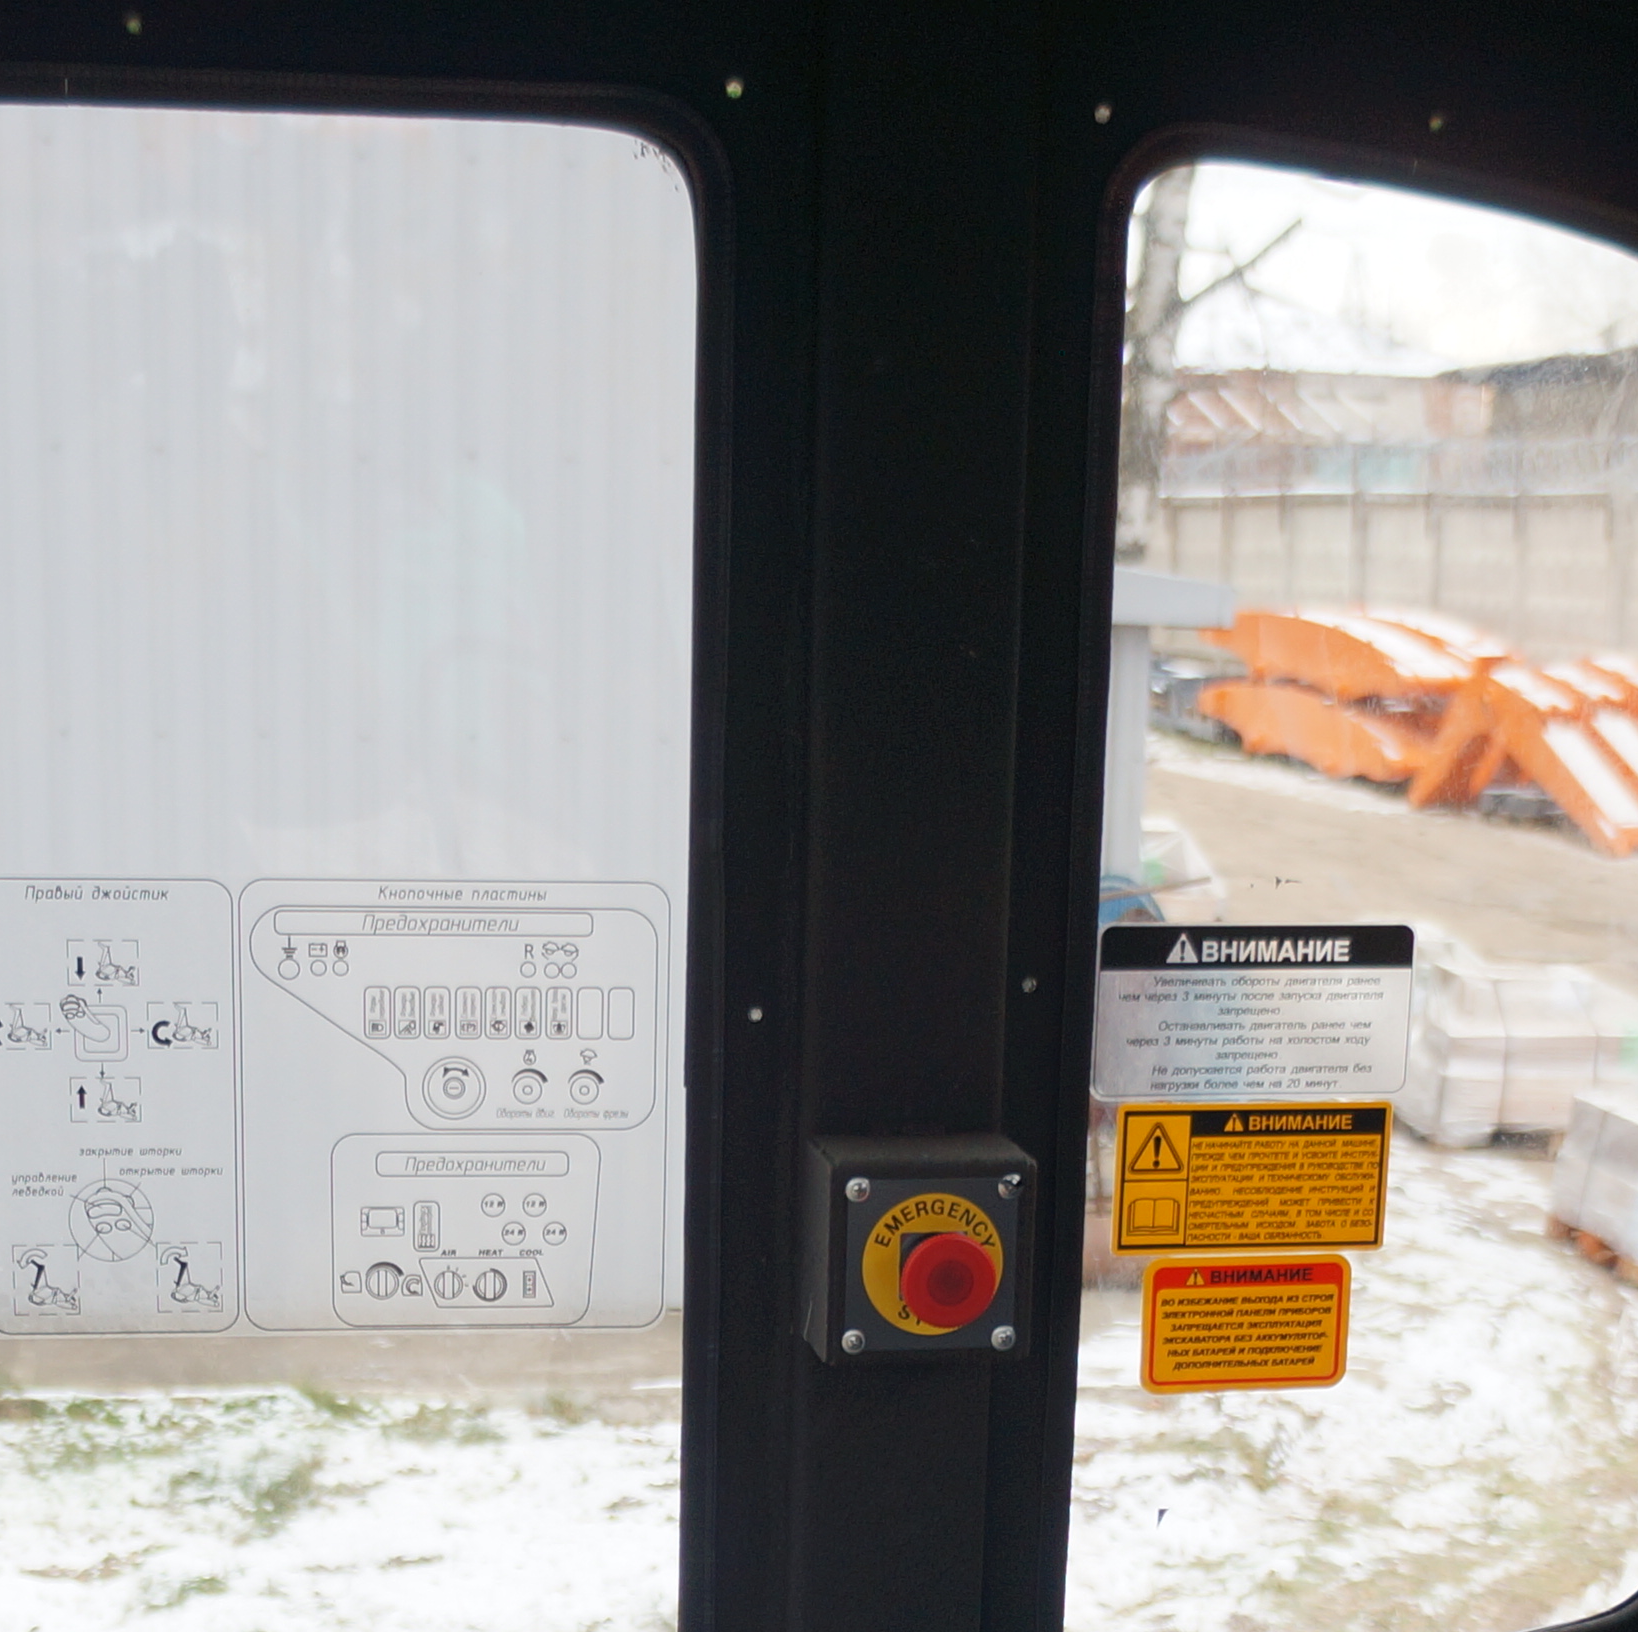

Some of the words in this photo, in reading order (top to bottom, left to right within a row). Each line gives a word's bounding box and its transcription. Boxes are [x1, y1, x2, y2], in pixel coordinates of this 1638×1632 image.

[25, 885, 83, 903] Правый
[92, 886, 168, 900] джойстик
[378, 886, 462, 901] Кнопочные
[472, 889, 547, 901] пластины
[362, 914, 520, 935] Предохранители
[525, 944, 534, 958] R
[1202, 939, 1351, 963] ВНИМАНИЕ
[1154, 976, 1226, 987] Увеличивать
[1232, 977, 1279, 987] обороты
[1284, 977, 1342, 987] двигателя
[1347, 977, 1380, 987] ранее
[1118, 992, 1140, 1002] чем
[1145, 992, 1178, 1004] через
[1182, 991, 1189, 1002] 3
[1194, 993, 1235, 1003] минуты
[1240, 992, 1273, 1002] после
[1279, 992, 1322, 1003] запуска
[1326, 991, 1384, 1002] двигателя
[1158, 1020, 1245, 1032] Останавливать
[1249, 1021, 1306, 1032] двигатель
[1312, 1021, 1345, 1032] ранее
[1351, 1020, 1372, 1030] чем
[1127, 1037, 1159, 1048] через
[1164, 1036, 1171, 1046] 3
[1175, 1036, 1217, 1047] минуты
[1222, 1036, 1264, 1047] работы
[1269, 1036, 1282, 1045] на
[1287, 1035, 1340, 1046] холостом
[1345, 1035, 1371, 1046] ходу
[1152, 1066, 1167, 1076] Не
[1172, 1065, 1242, 1077] допускается
[1247, 1065, 1286, 1076] работа
[1291, 1064, 1348, 1075] двигателя
[1353, 1063, 1372, 1074] без
[1150, 1080, 1199, 1091] нагрузки
[1204, 1080, 1238, 1089] более
[1243, 1080, 1264, 1089] чем
[1269, 1079, 1282, 1089] на
[1286, 1078, 1300, 1089] 20
[1249, 1115, 1353, 1131] ВНИМАНИЕ
[1205, 1141, 1252, 1150] НАЧИНАЙТЕ
[1254, 1141, 1285, 1149] РАБОТУ
[1303, 1139, 1336, 1149] ДАННОЙ
[79, 1148, 133, 1158] закрытие
[139, 1148, 182, 1157] шторки
[1191, 1153, 1224, 1161] ПРЕЖДЕ
[1248, 1152, 1290, 1160] ПРОЧТЕТЕ
[1302, 1151, 1337, 1159] УСВОИТЕ
[119, 1167, 175, 1176] открытие
[181, 1167, 223, 1176] шторки
[405, 1157, 546, 1175] Предохранители
[1220, 1163, 1296, 1172] ПРЕДУПРЕЖДЕНИЯ
[1307, 1162, 1363, 1171] РУКОВОДСТВЕ
[12, 1173, 77, 1185] управление
[1190, 1175, 1254, 1183] ЭКСПЛУАТАЦИИ
[1267, 1174, 1330, 1182] ТЕХНИЧЕСКОМУ
[12, 1185, 64, 1197] лебедкой
[1233, 1186, 1303, 1195] НЕСОБЛЮДЕНИЕ
[1309, 1184, 1364, 1194] ИНСТРУКЦИЙ
[1369, 1185, 1376, 1193] И
[1189, 1199, 1269, 1208] ПРЕДУПРЕЖДЕНИЙ
[1317, 1198, 1362, 1206] ПРИВЕСТИ
[1188, 1211, 1244, 1219] НЕСЧАСТНЫМ
[1296, 1210, 1301, 1218] В
[1324, 1209, 1350, 1217] ЧИСЛЕ
[874, 1199, 996, 1248] EMERGENCY
[1188, 1222, 1249, 1231] СМЕРТЕЛЬНЫМ
[1187, 1233, 1231, 1241] ПАСНОСТИ
[1238, 1232, 1261, 1240] ВАША
[1210, 1267, 1313, 1283] ВНИМАНИЕ
[1161, 1299, 1175, 1307] ВО
[1177, 1297, 1238, 1306] ИЗБЕЖАНИЕ
[1241, 1296, 1283, 1305] ВЫХОДА
[1287, 1295, 1299, 1303] ИЗ
[1302, 1294, 1334, 1303] СТРОЯ
[1162, 1309, 1234, 1319] ЭЛЕКТРОННОЙ
[1236, 1309, 1276, 1318] ПАНЕЛИ
[1278, 1307, 1332, 1316] ПРИБОРОВ
[1171, 1322, 1244, 1332] ЗАПРЕЩАЕТСЯ
[1247, 1320, 1323, 1331] ЭКСПЛУАТАЦИЯ
[1162, 1335, 1231, 1345] ЭКСКАВАТОРА
[1234, 1335, 1252, 1343] БЕЗ
[1255, 1332, 1329, 1342] АККУМУЛЯТОР-
[1167, 1349, 1189, 1358] НЫХ
[1192, 1346, 1236, 1356] БАТАРЕЙ
[1238, 1347, 1245, 1355] И
[1247, 1344, 1323, 1356] ПОДКЛЮЧЕНИЕ
[1173, 1360, 1268, 1372] ДОПОЛНИТЕЛЬНЫХ
[1271, 1356, 1314, 1367] БАТАРЕЙ
